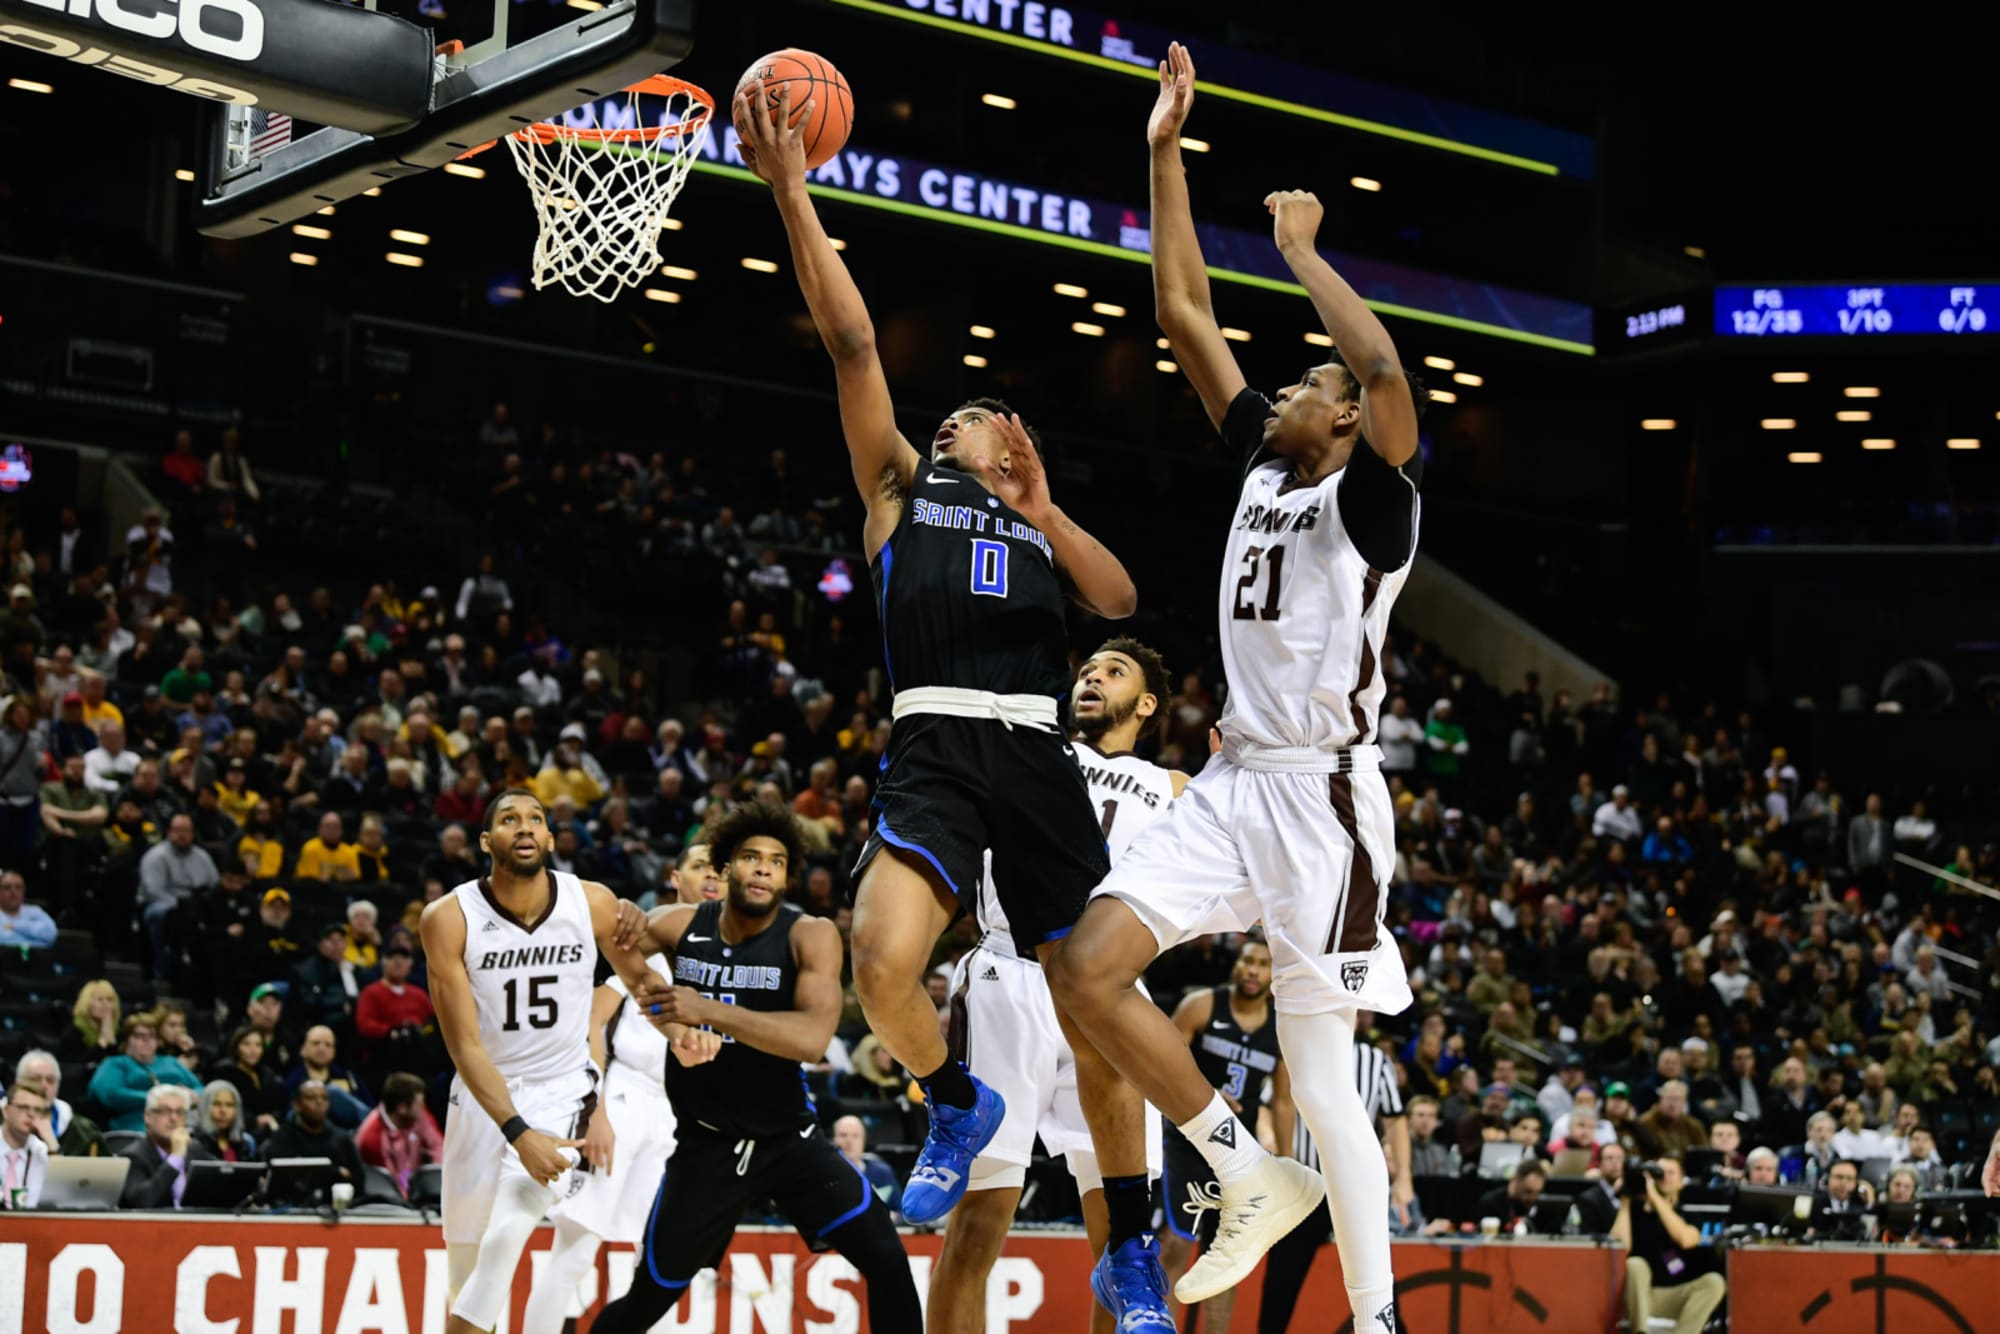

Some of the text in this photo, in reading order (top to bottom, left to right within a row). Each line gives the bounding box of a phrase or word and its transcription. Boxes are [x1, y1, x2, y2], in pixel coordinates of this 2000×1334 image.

[658, 112, 900, 197] BARAYS
[919, 168, 1092, 238] CENTER
[1950, 287, 1976, 307] FT
[1837, 308, 1893, 335] 1/10
[912, 498, 1053, 568] SAINT LOU
[971, 538, 1009, 599] 0
[1233, 545, 1286, 620] 21
[1080, 764, 1161, 810] NNIES
[478, 944, 583, 970] BONNIES
[720, 964, 781, 990] LOUIS
[502, 975, 558, 1031] 15
[1222, 1062, 1248, 1100] 3
